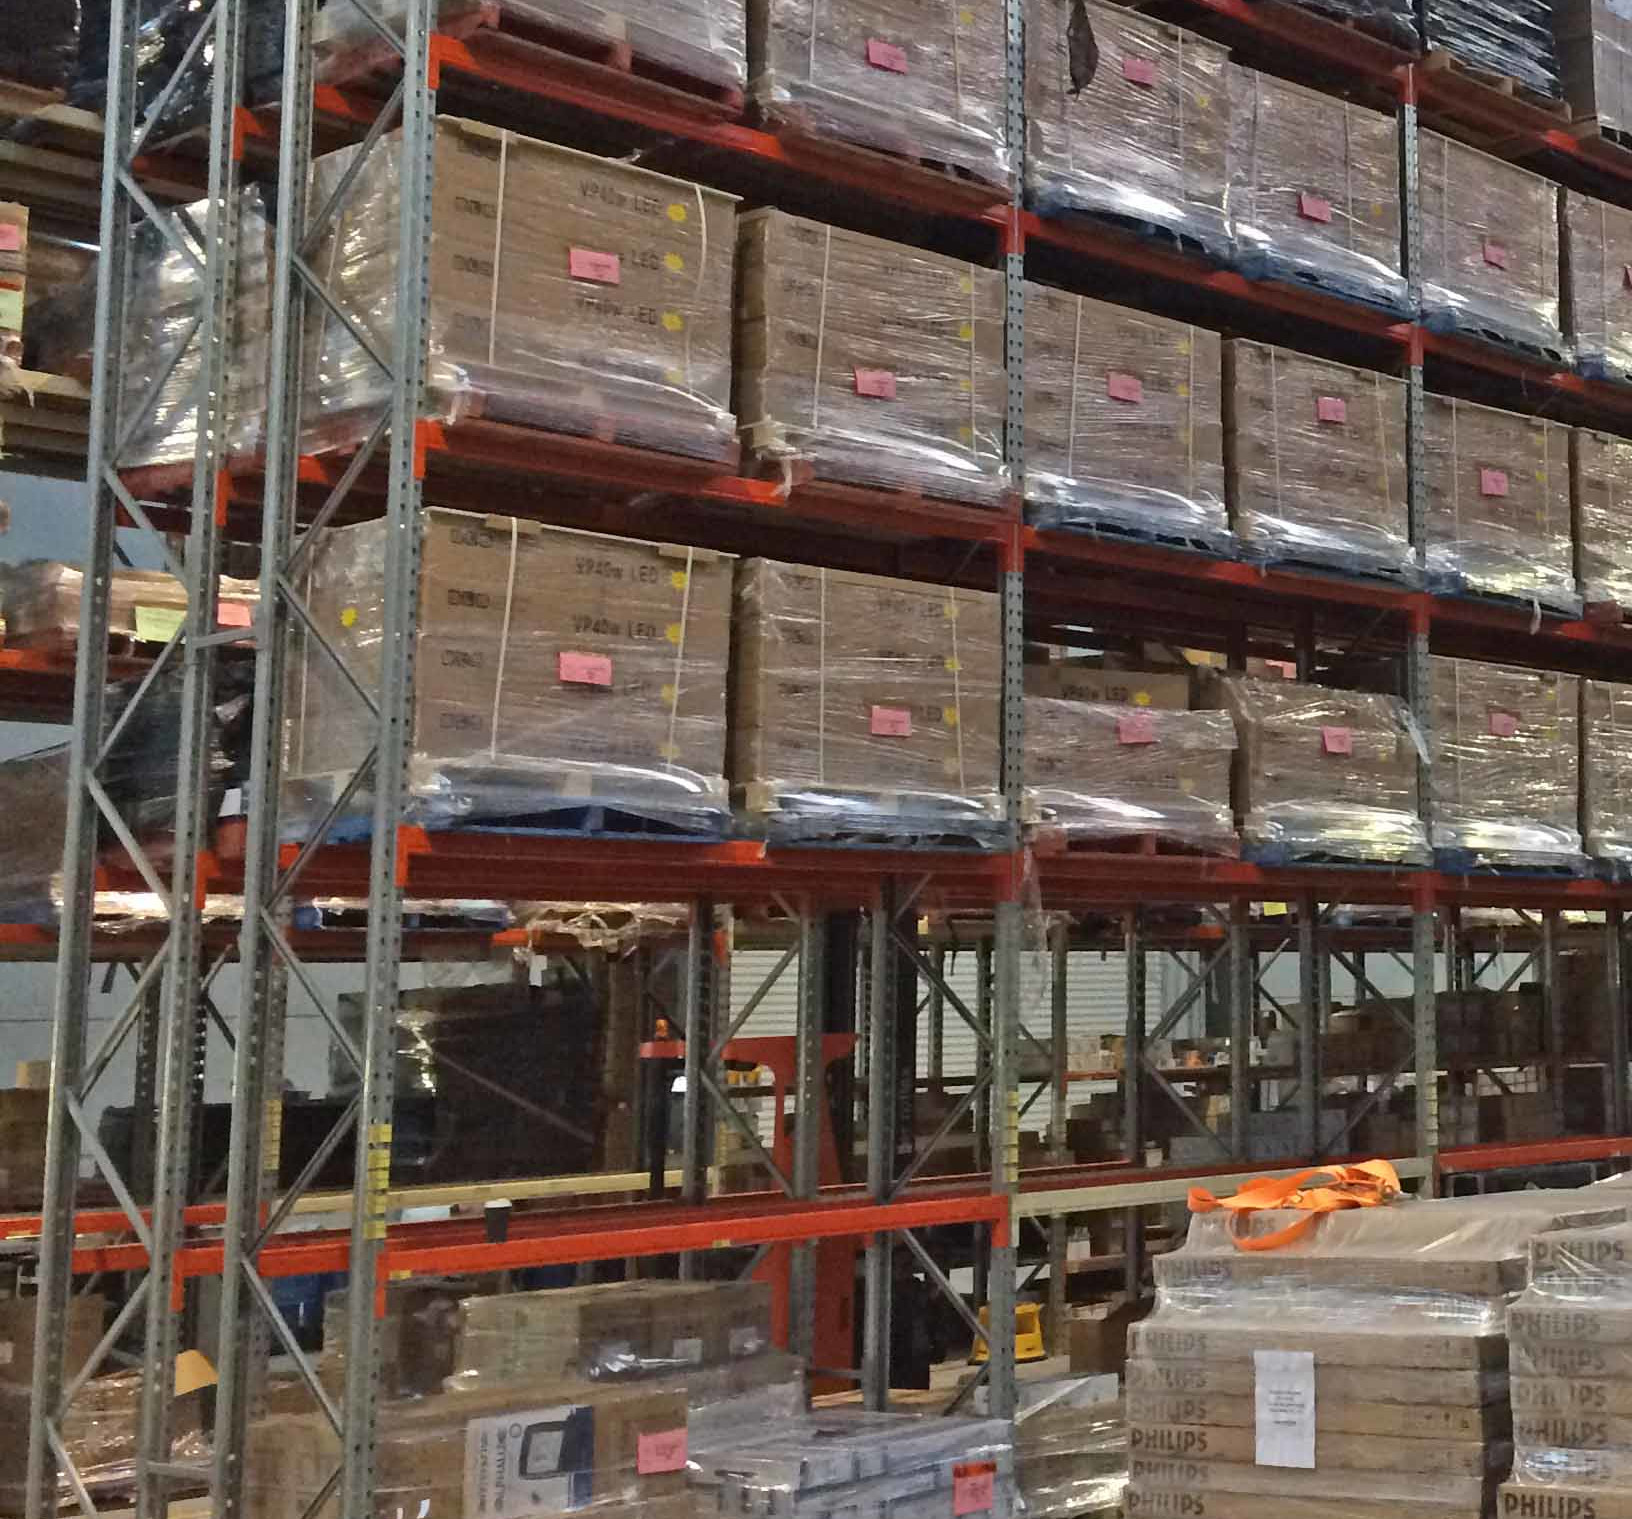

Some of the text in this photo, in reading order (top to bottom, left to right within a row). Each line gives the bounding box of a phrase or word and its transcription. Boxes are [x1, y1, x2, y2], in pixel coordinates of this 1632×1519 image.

[630, 563, 658, 585] LED
[626, 619, 657, 639] LED
[1131, 1427, 1208, 1453] PHILIPS
[1127, 1490, 1205, 1517] PHILIPS
[1503, 1492, 1596, 1519] PHILIPS
